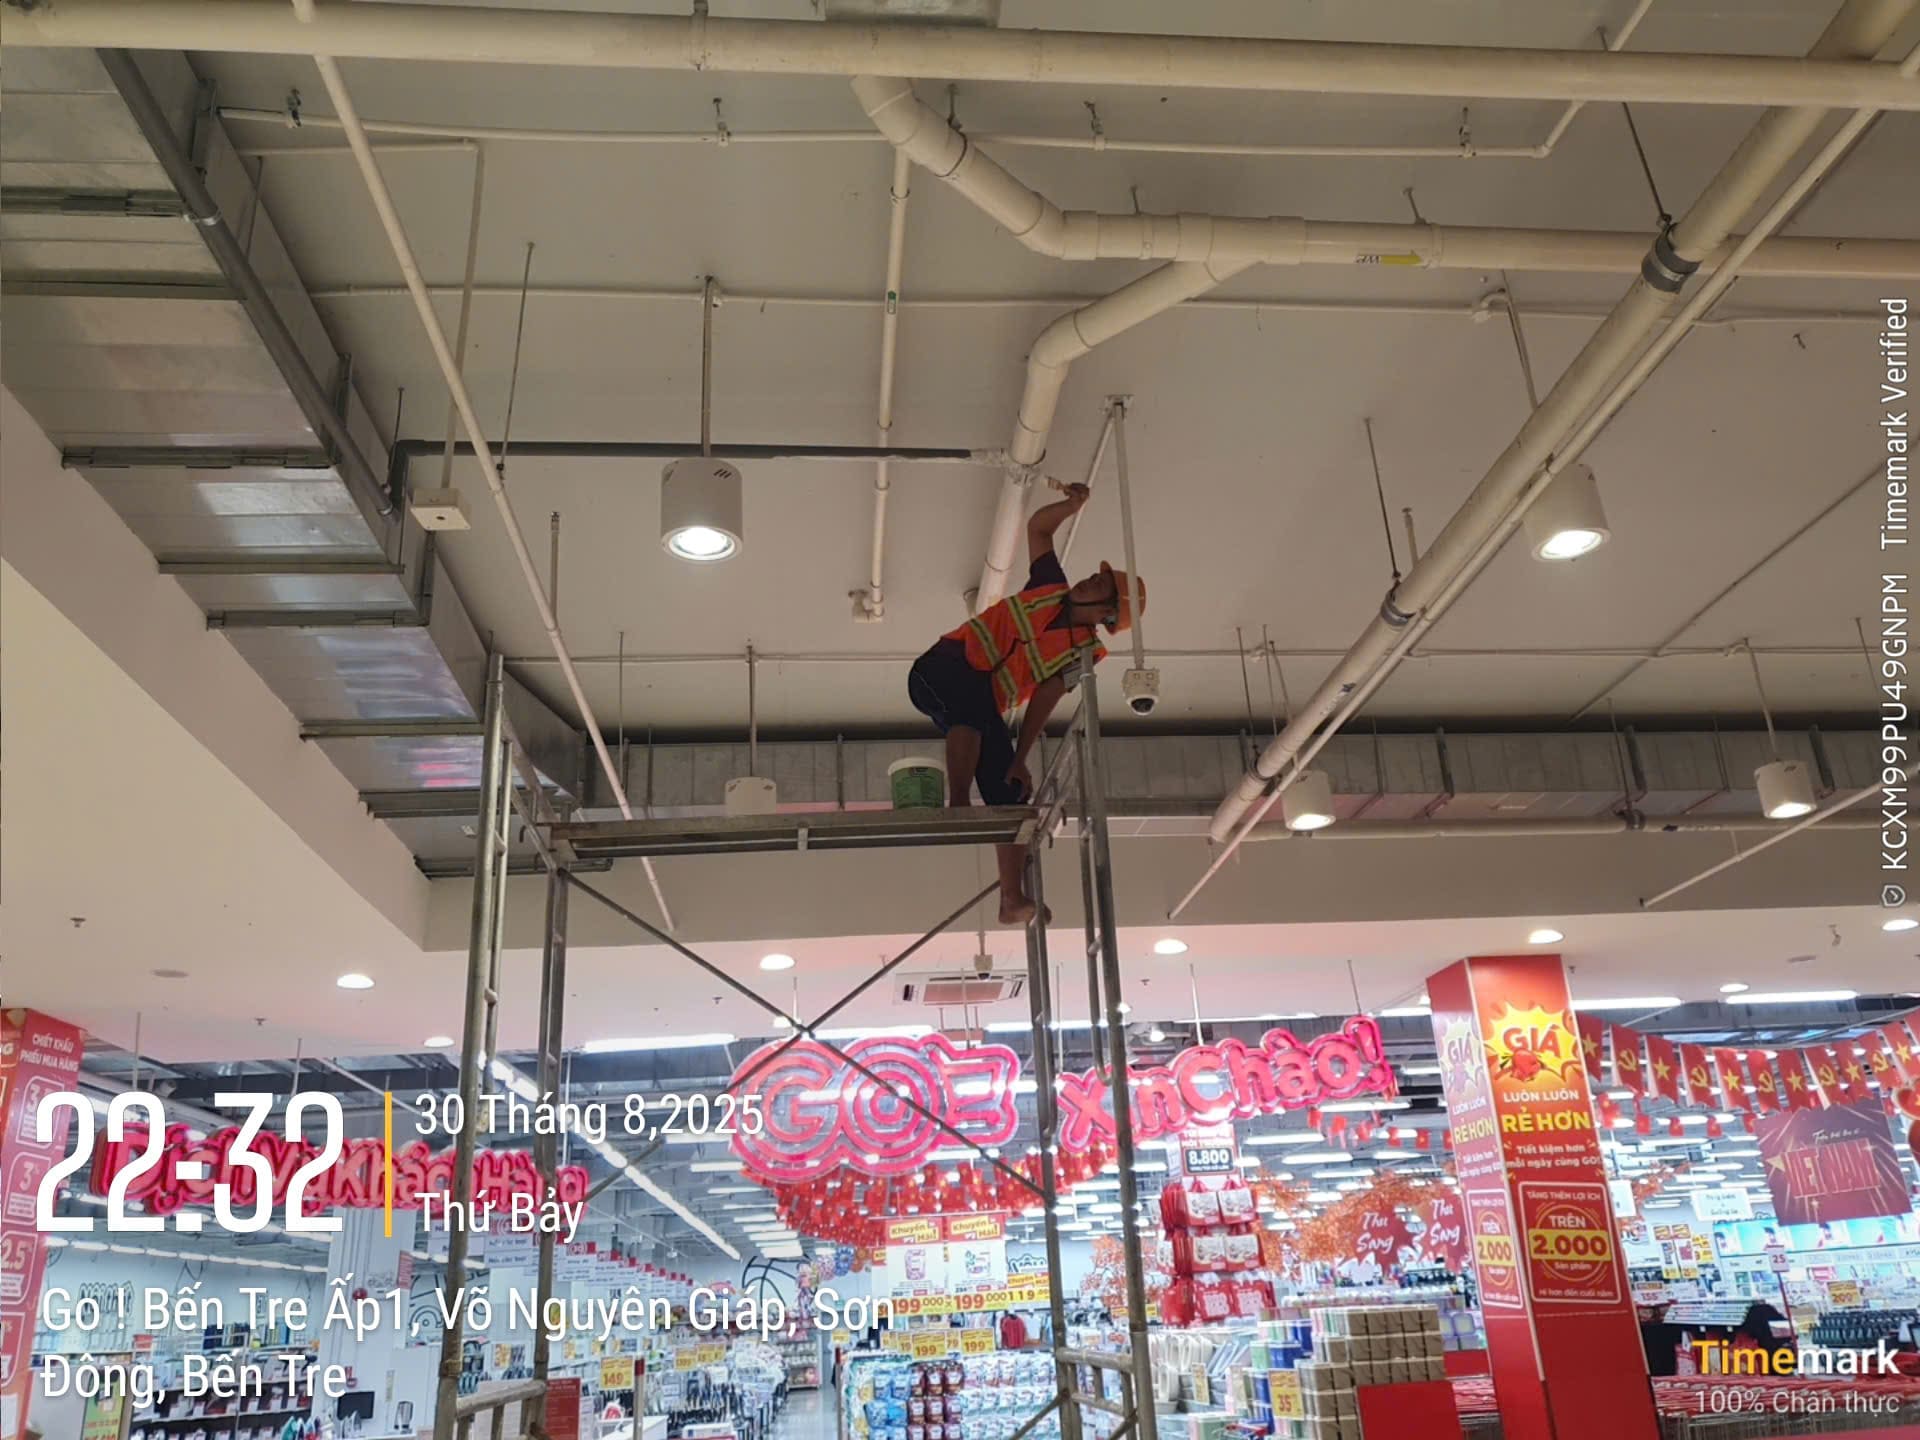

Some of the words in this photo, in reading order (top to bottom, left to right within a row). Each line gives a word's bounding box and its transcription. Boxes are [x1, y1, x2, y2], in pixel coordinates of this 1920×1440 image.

[1503, 1024, 1561, 1058] GIÁ
[1503, 1089, 1540, 1102] LUÔN
[1542, 1087, 1579, 1100] LUÔN
[1502, 1106, 1534, 1132] RẺ
[1536, 1109, 1591, 1131] HƠN
[1188, 1149, 1230, 1165] 8.800
[1548, 1212, 1586, 1229] TRÊN
[1532, 1234, 1608, 1257] 2.000
